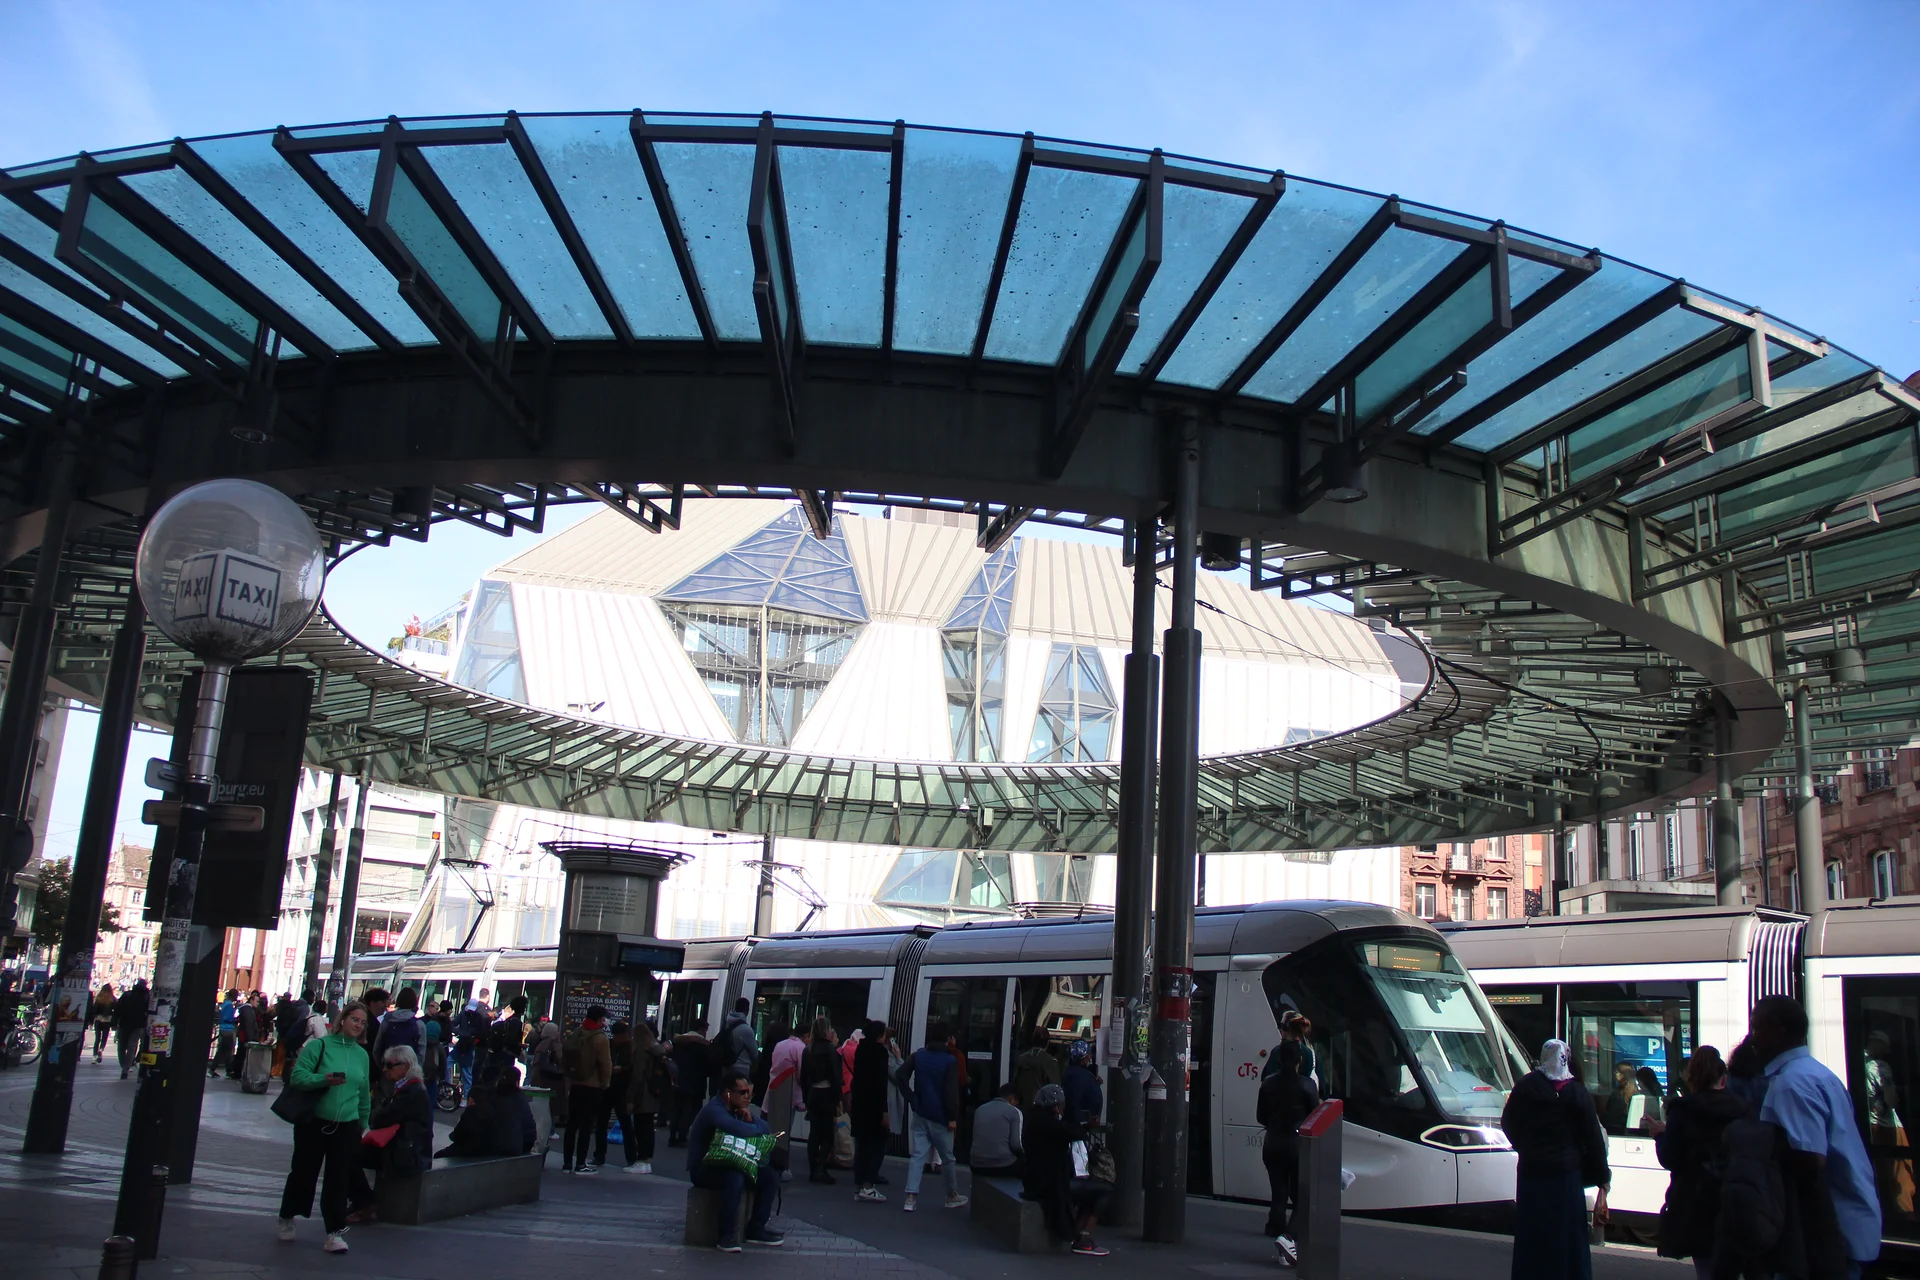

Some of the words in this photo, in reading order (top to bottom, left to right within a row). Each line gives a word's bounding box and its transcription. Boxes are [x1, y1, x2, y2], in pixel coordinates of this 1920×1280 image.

[180, 576, 208, 598] TAXI
[228, 578, 272, 608] TAXI
[566, 996, 604, 1004] ORCHESTRA
